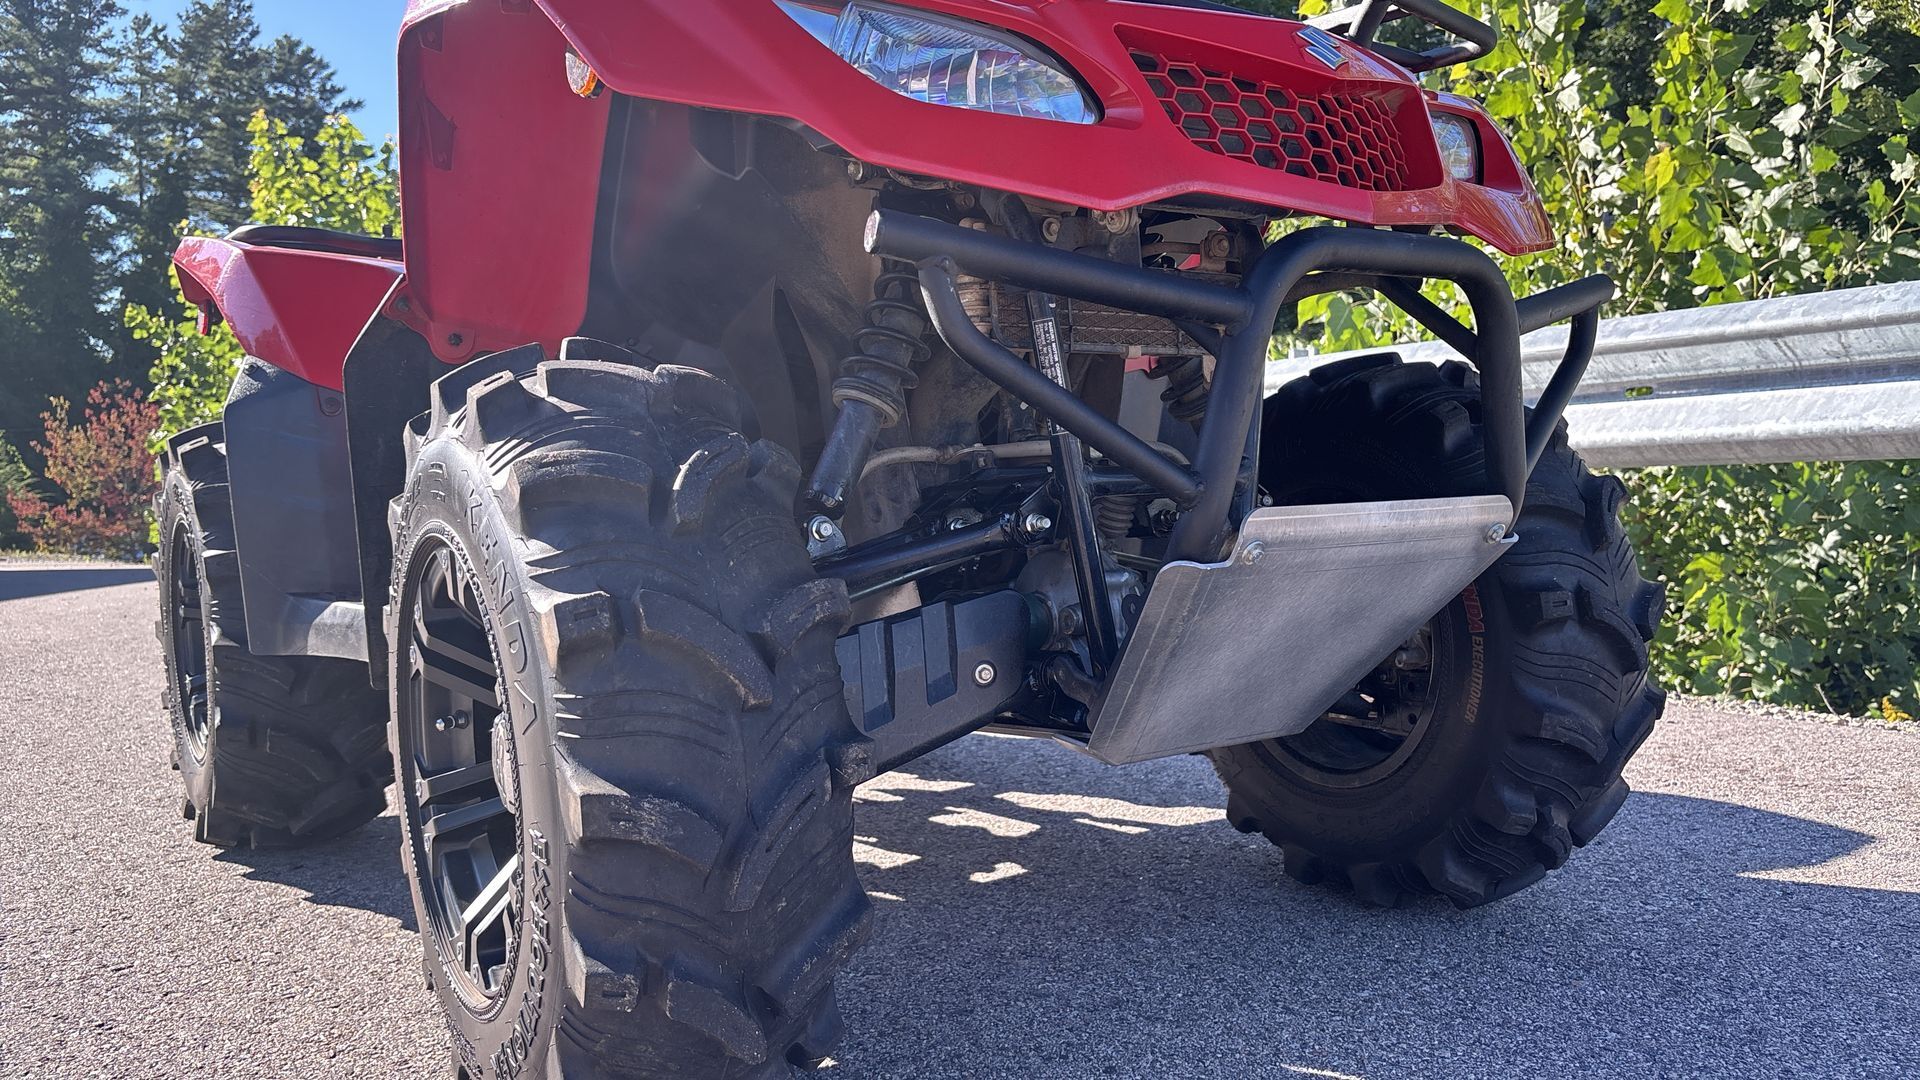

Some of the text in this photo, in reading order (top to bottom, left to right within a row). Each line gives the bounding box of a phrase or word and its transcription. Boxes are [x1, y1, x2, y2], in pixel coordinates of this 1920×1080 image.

[464, 478, 537, 736] KENDA
[1461, 583, 1486, 723] NDA EXECUTIONER
